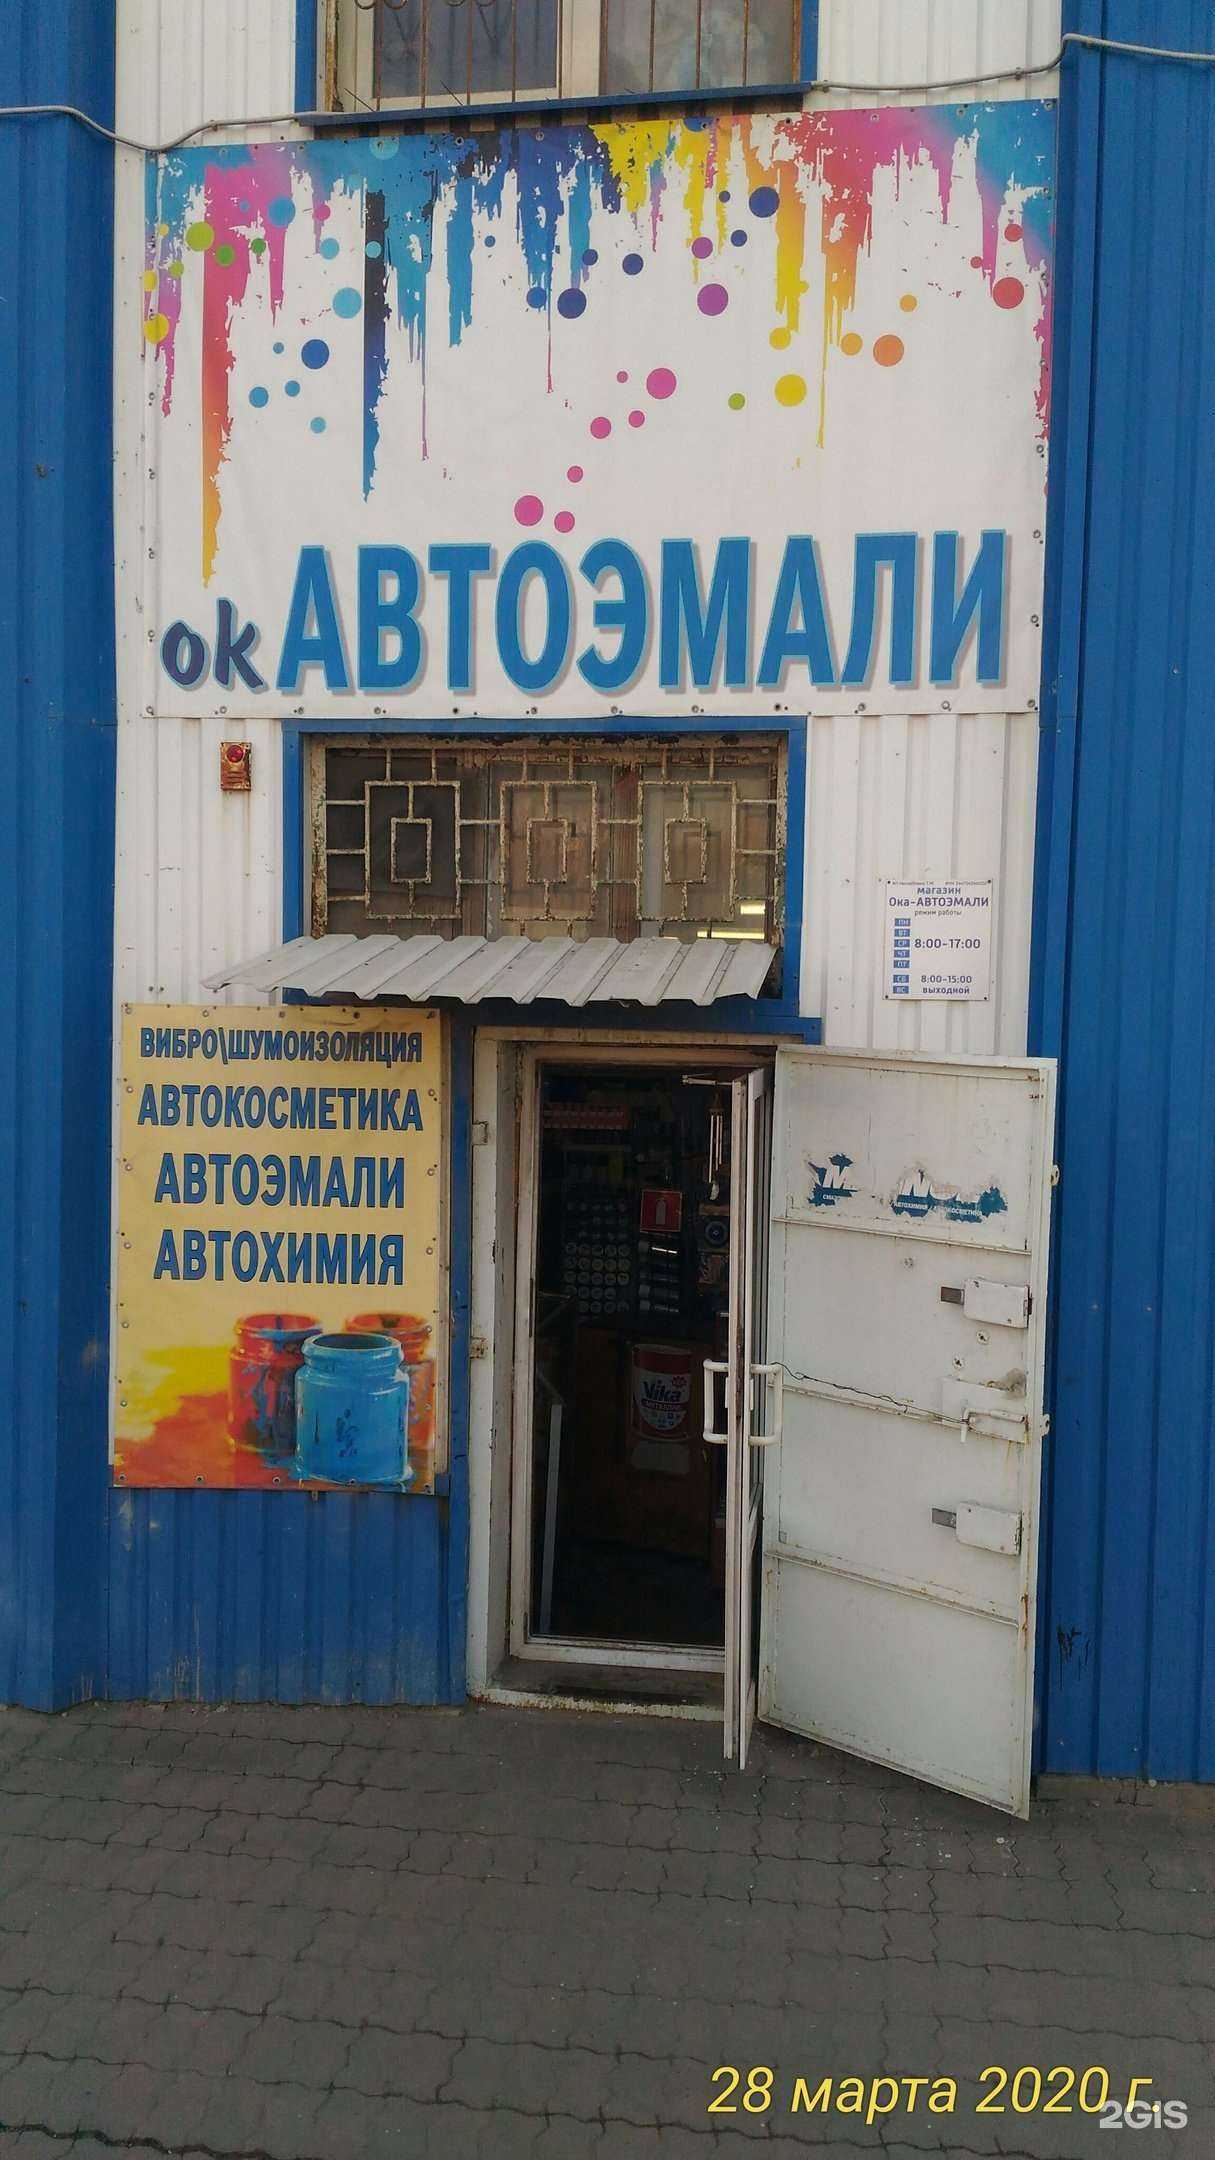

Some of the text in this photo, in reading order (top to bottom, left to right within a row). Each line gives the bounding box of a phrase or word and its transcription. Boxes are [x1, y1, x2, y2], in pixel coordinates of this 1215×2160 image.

[276, 529, 1008, 692] АВТОЭМАЛИ
[916, 887, 961, 895] магазин
[889, 897, 989, 907] Ока-АВТОЭМАЛИ
[938, 909, 962, 917] работы
[914, 938, 981, 949] 8:00-17:00
[920, 975, 972, 984] 8:00-15:00
[922, 985, 970, 994] выходной
[140, 1027, 423, 1068] ВИБРО\ШУМОИЗОЛЯЦИЯ
[137, 1083, 424, 1131] АВТОКОСМЕТИКА
[154, 1152, 405, 1209] АВТОЭМАЛИ
[153, 1229, 404, 1285] АВТОХИМИЯ
[643, 1379, 682, 1402] Vika
